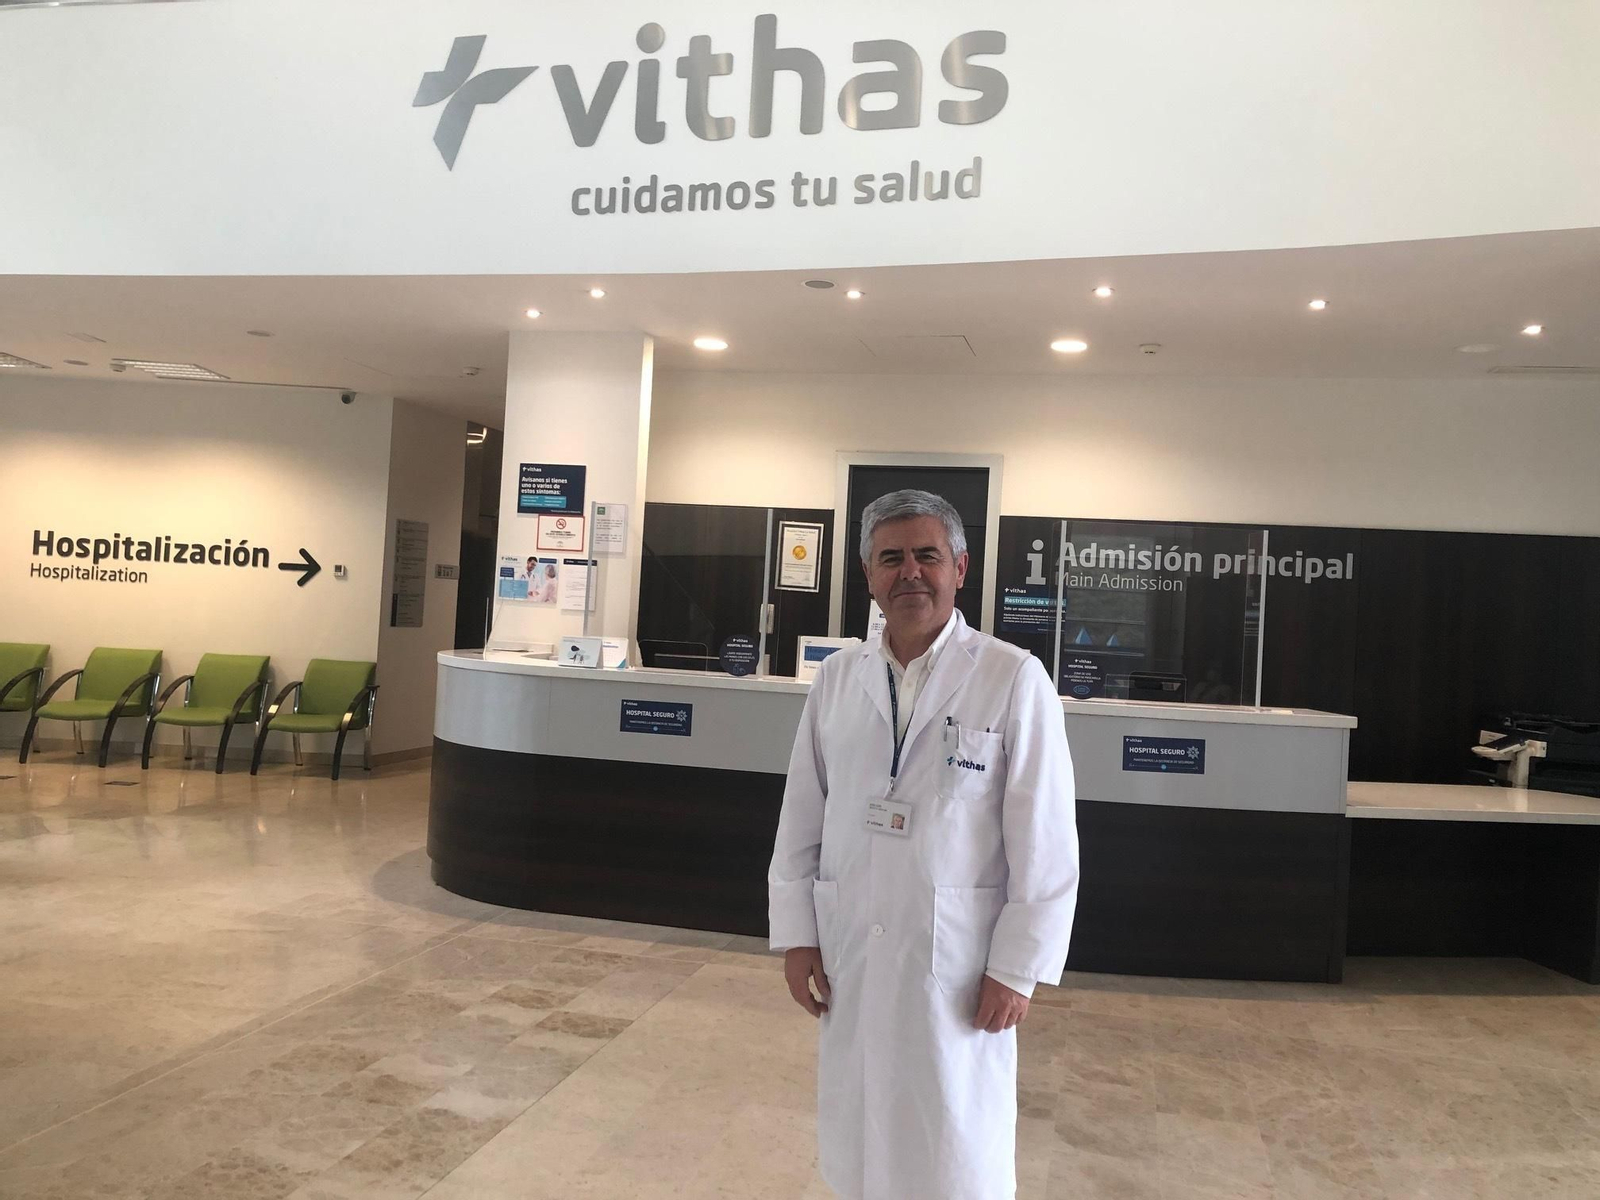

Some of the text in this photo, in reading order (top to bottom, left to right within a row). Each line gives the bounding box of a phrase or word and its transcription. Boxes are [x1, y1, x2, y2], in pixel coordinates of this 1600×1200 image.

[549, 13, 1010, 148] vithas
[570, 156, 983, 216] cuidamos tu salud
[32, 529, 270, 568] Hospitalización
[1055, 542, 1202, 573] Admisión
[1213, 551, 1354, 584] principal
[30, 562, 148, 583] Hospitalization
[1055, 572, 1184, 592] Main Admission
[957, 759, 986, 772] vithas
